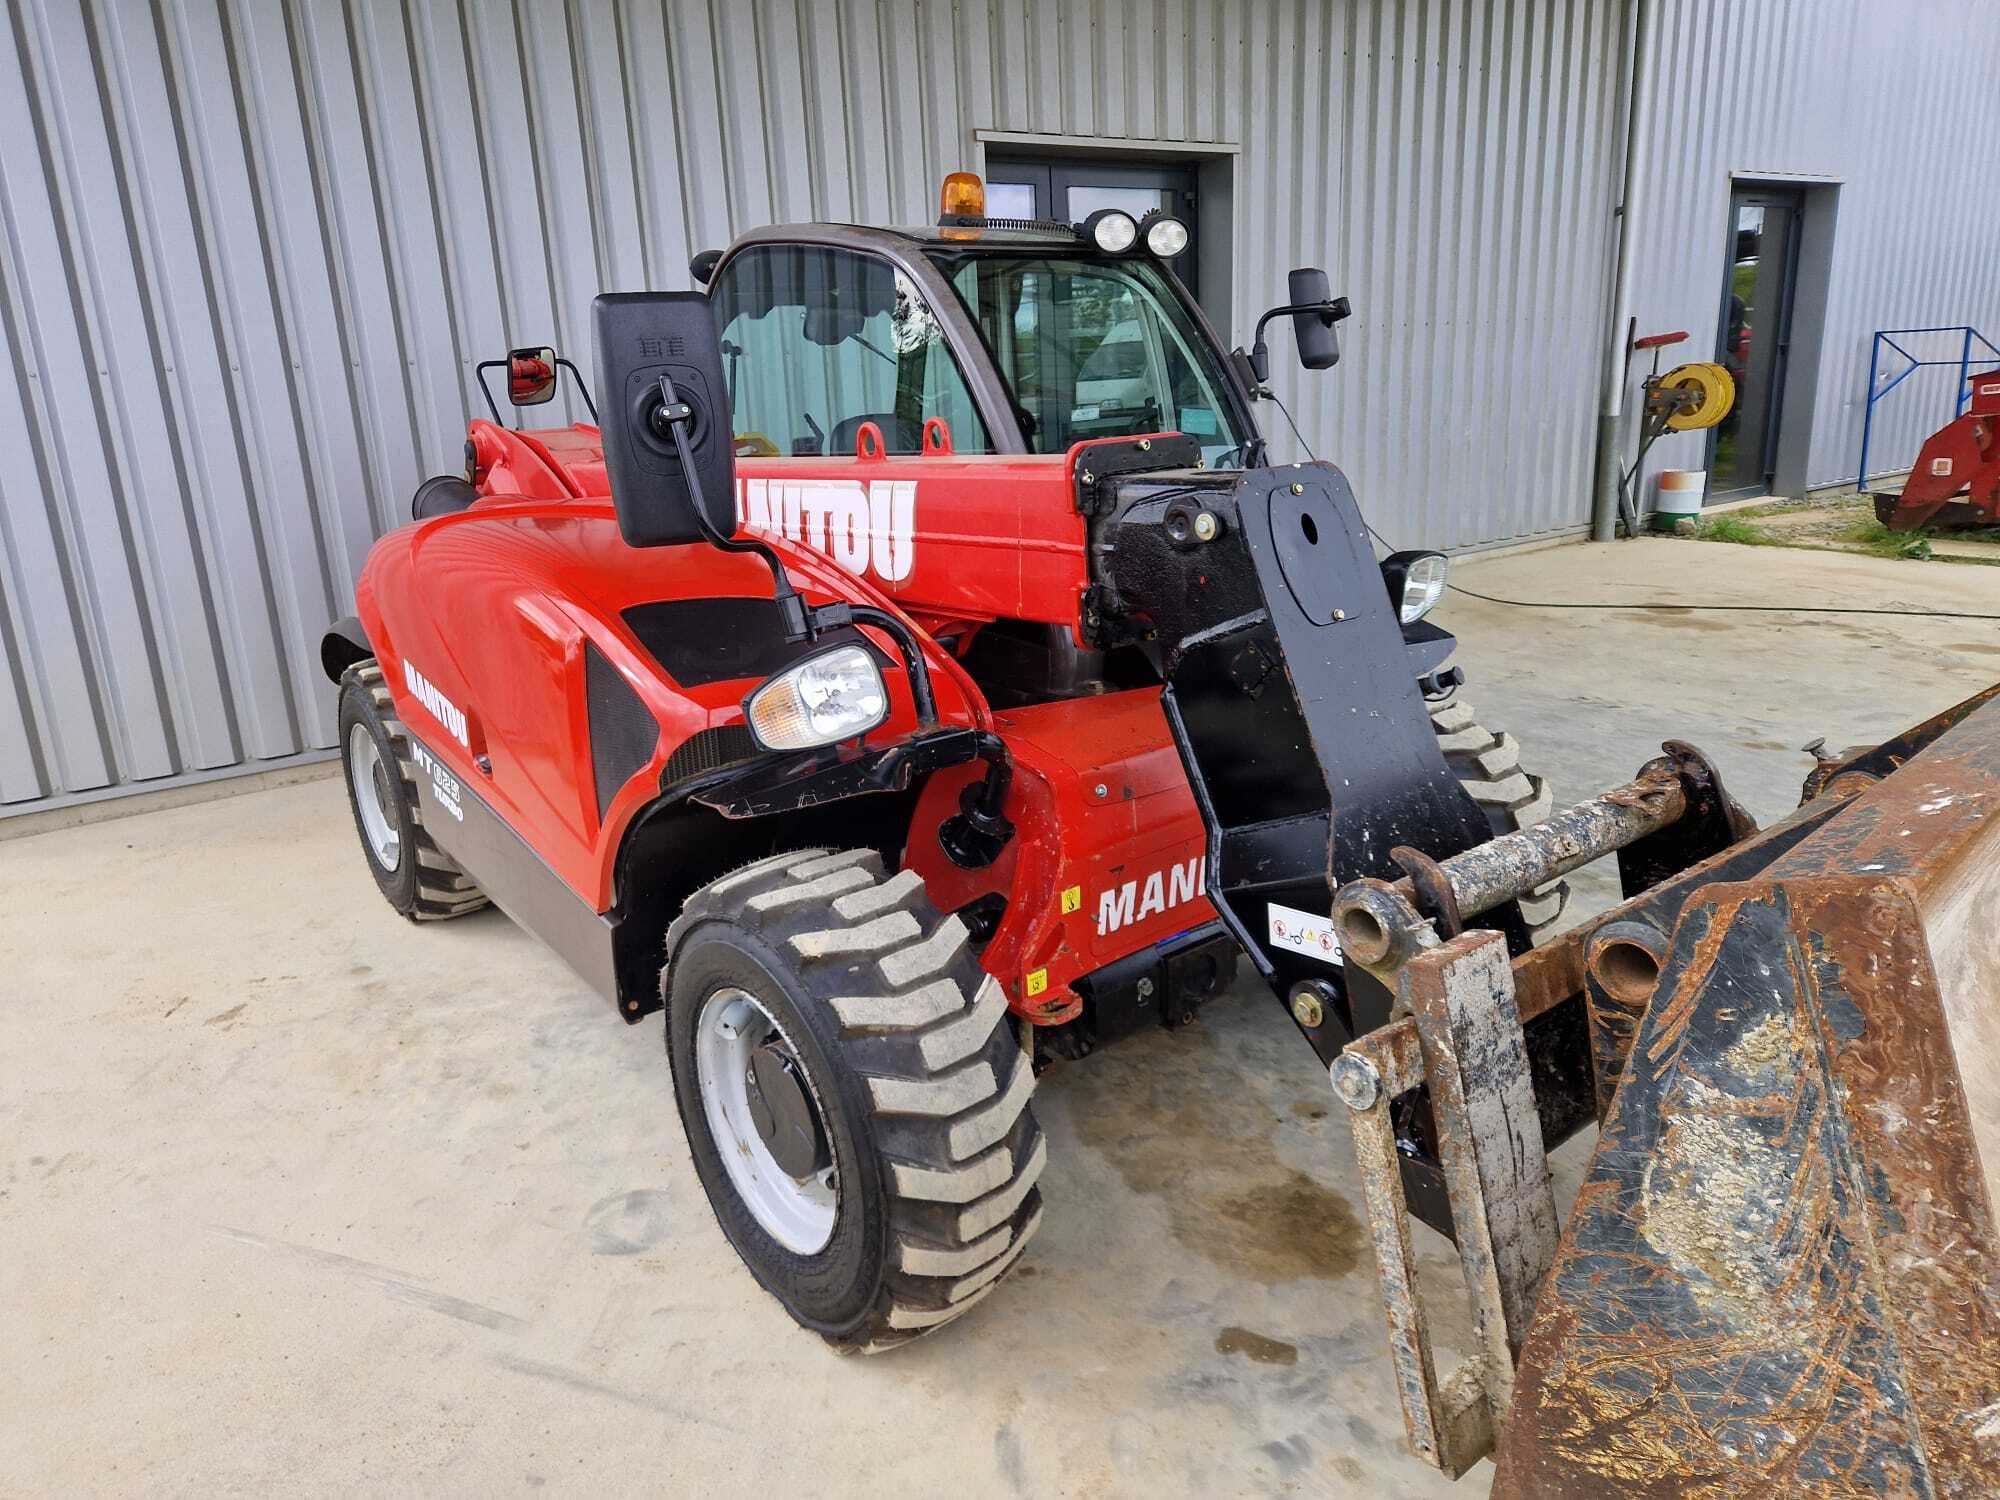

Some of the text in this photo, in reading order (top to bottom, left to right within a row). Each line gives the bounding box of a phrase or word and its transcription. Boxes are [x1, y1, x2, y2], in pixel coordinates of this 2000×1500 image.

[736, 478, 918, 582] NITOU
[403, 657, 469, 747] MANITOU
[412, 741, 433, 775] MT
[432, 782, 464, 822] TURBO
